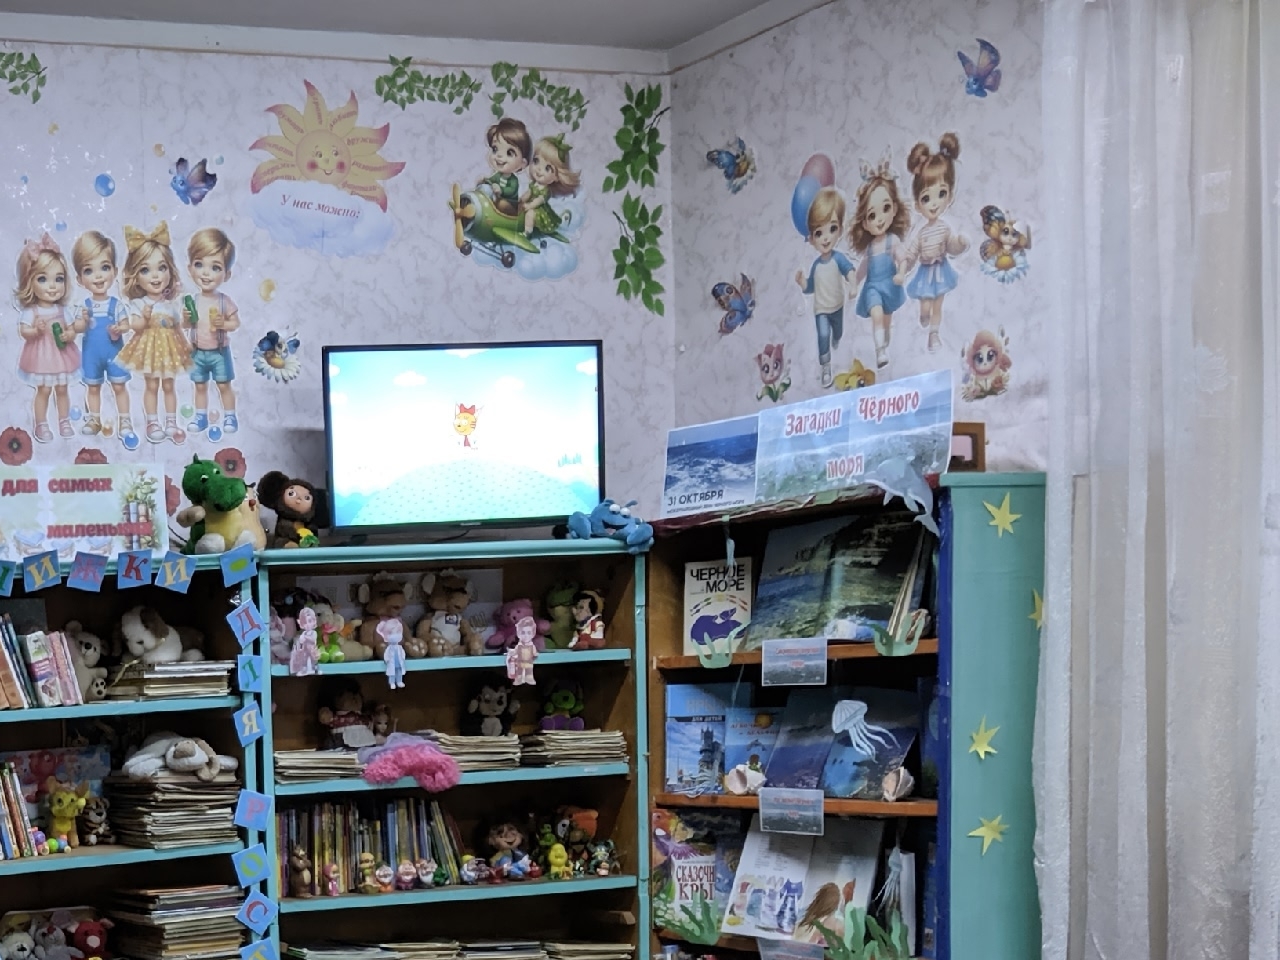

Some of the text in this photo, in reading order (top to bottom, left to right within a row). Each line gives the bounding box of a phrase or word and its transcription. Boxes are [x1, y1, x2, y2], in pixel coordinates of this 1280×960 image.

[280, 194, 361, 218] У нас можно:
[786, 391, 920, 436] Загадки Чёрного
[827, 455, 864, 478] моря
[1, 477, 38, 496] для
[48, 477, 113, 494] самых
[667, 489, 723, 506] 31 ОКТЯБРЯ
[47, 522, 153, 539] маленьких
[706, 578, 745, 593] МОРЕ
[676, 865, 716, 882] СКАЗОЧН
[679, 883, 714, 900] КРЫ
